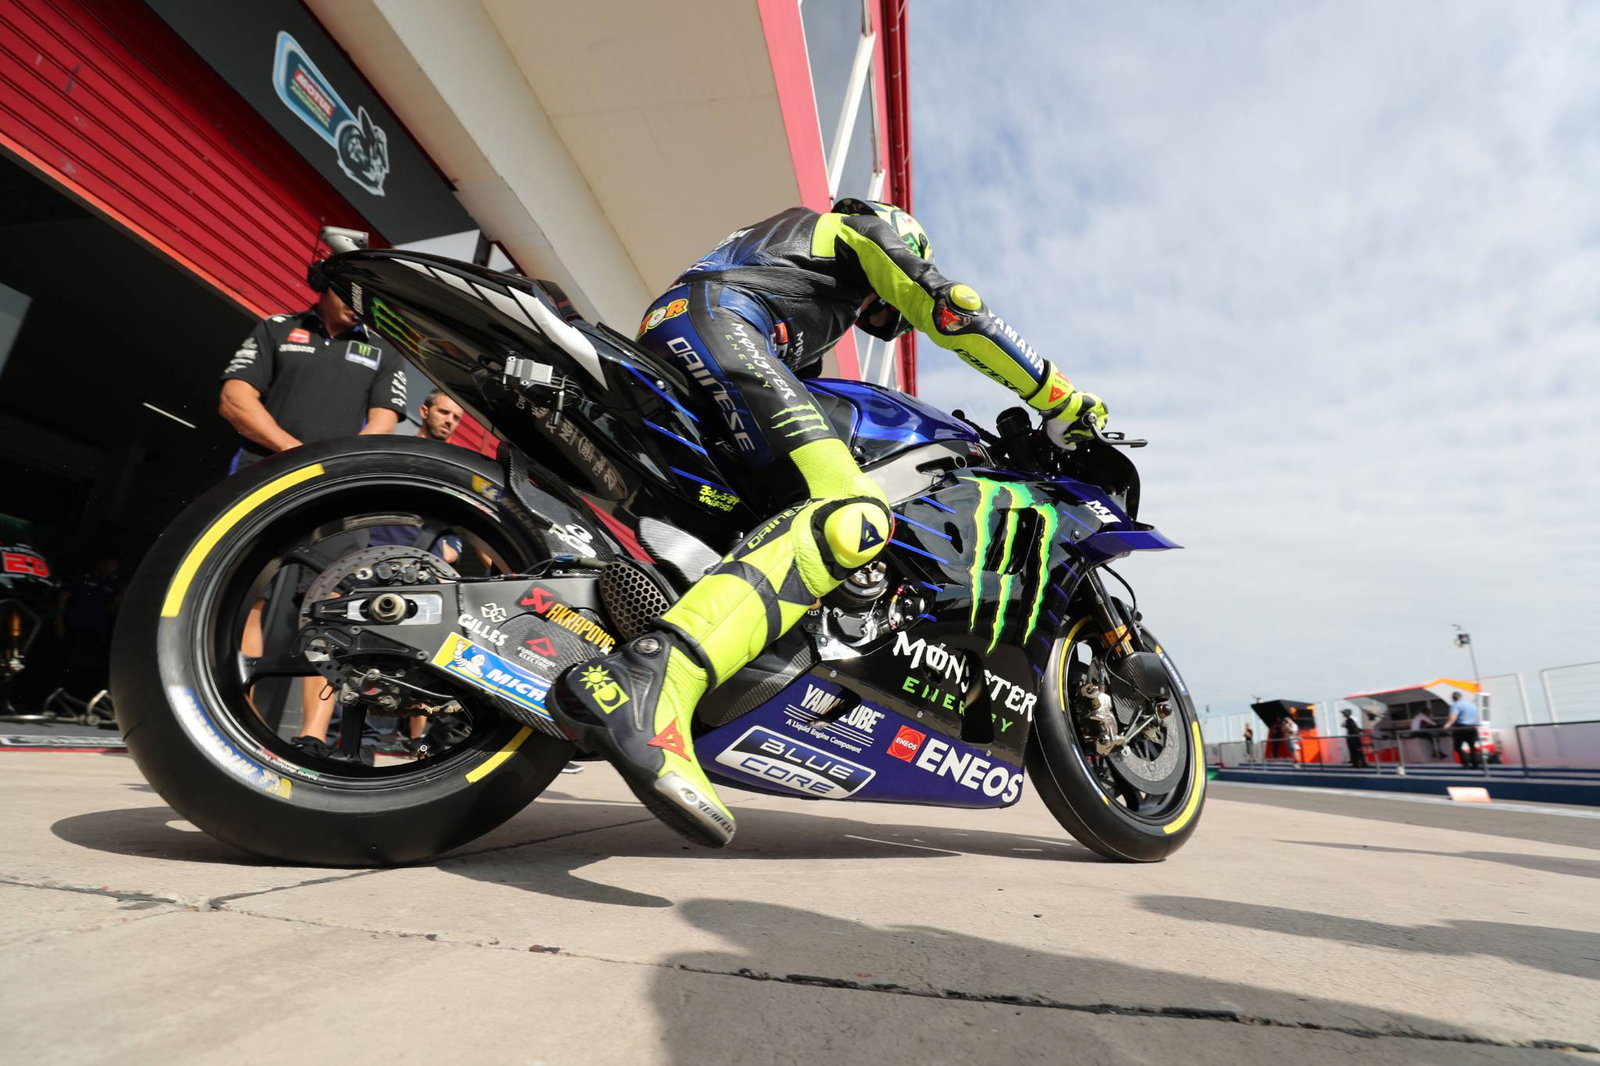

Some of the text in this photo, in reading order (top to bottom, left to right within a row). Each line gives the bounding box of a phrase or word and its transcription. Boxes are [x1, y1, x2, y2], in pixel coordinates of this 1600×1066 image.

[725, 333, 772, 389] ENERGY
[731, 322, 797, 400] MONSTER
[987, 309, 1045, 375] YAMAHA
[666, 336, 756, 451] DAINESE
[457, 613, 509, 647] GILLES
[485, 668, 548, 703] MICH
[902, 675, 1014, 734] ENERY
[759, 737, 855, 780] BLUE
[793, 720, 812, 735] Liquid
[811, 728, 830, 742] Engine
[829, 737, 862, 754] Component
[896, 737, 918, 751] ENEOS
[739, 757, 838, 795] CORE
[915, 737, 1024, 803] ENEOS
